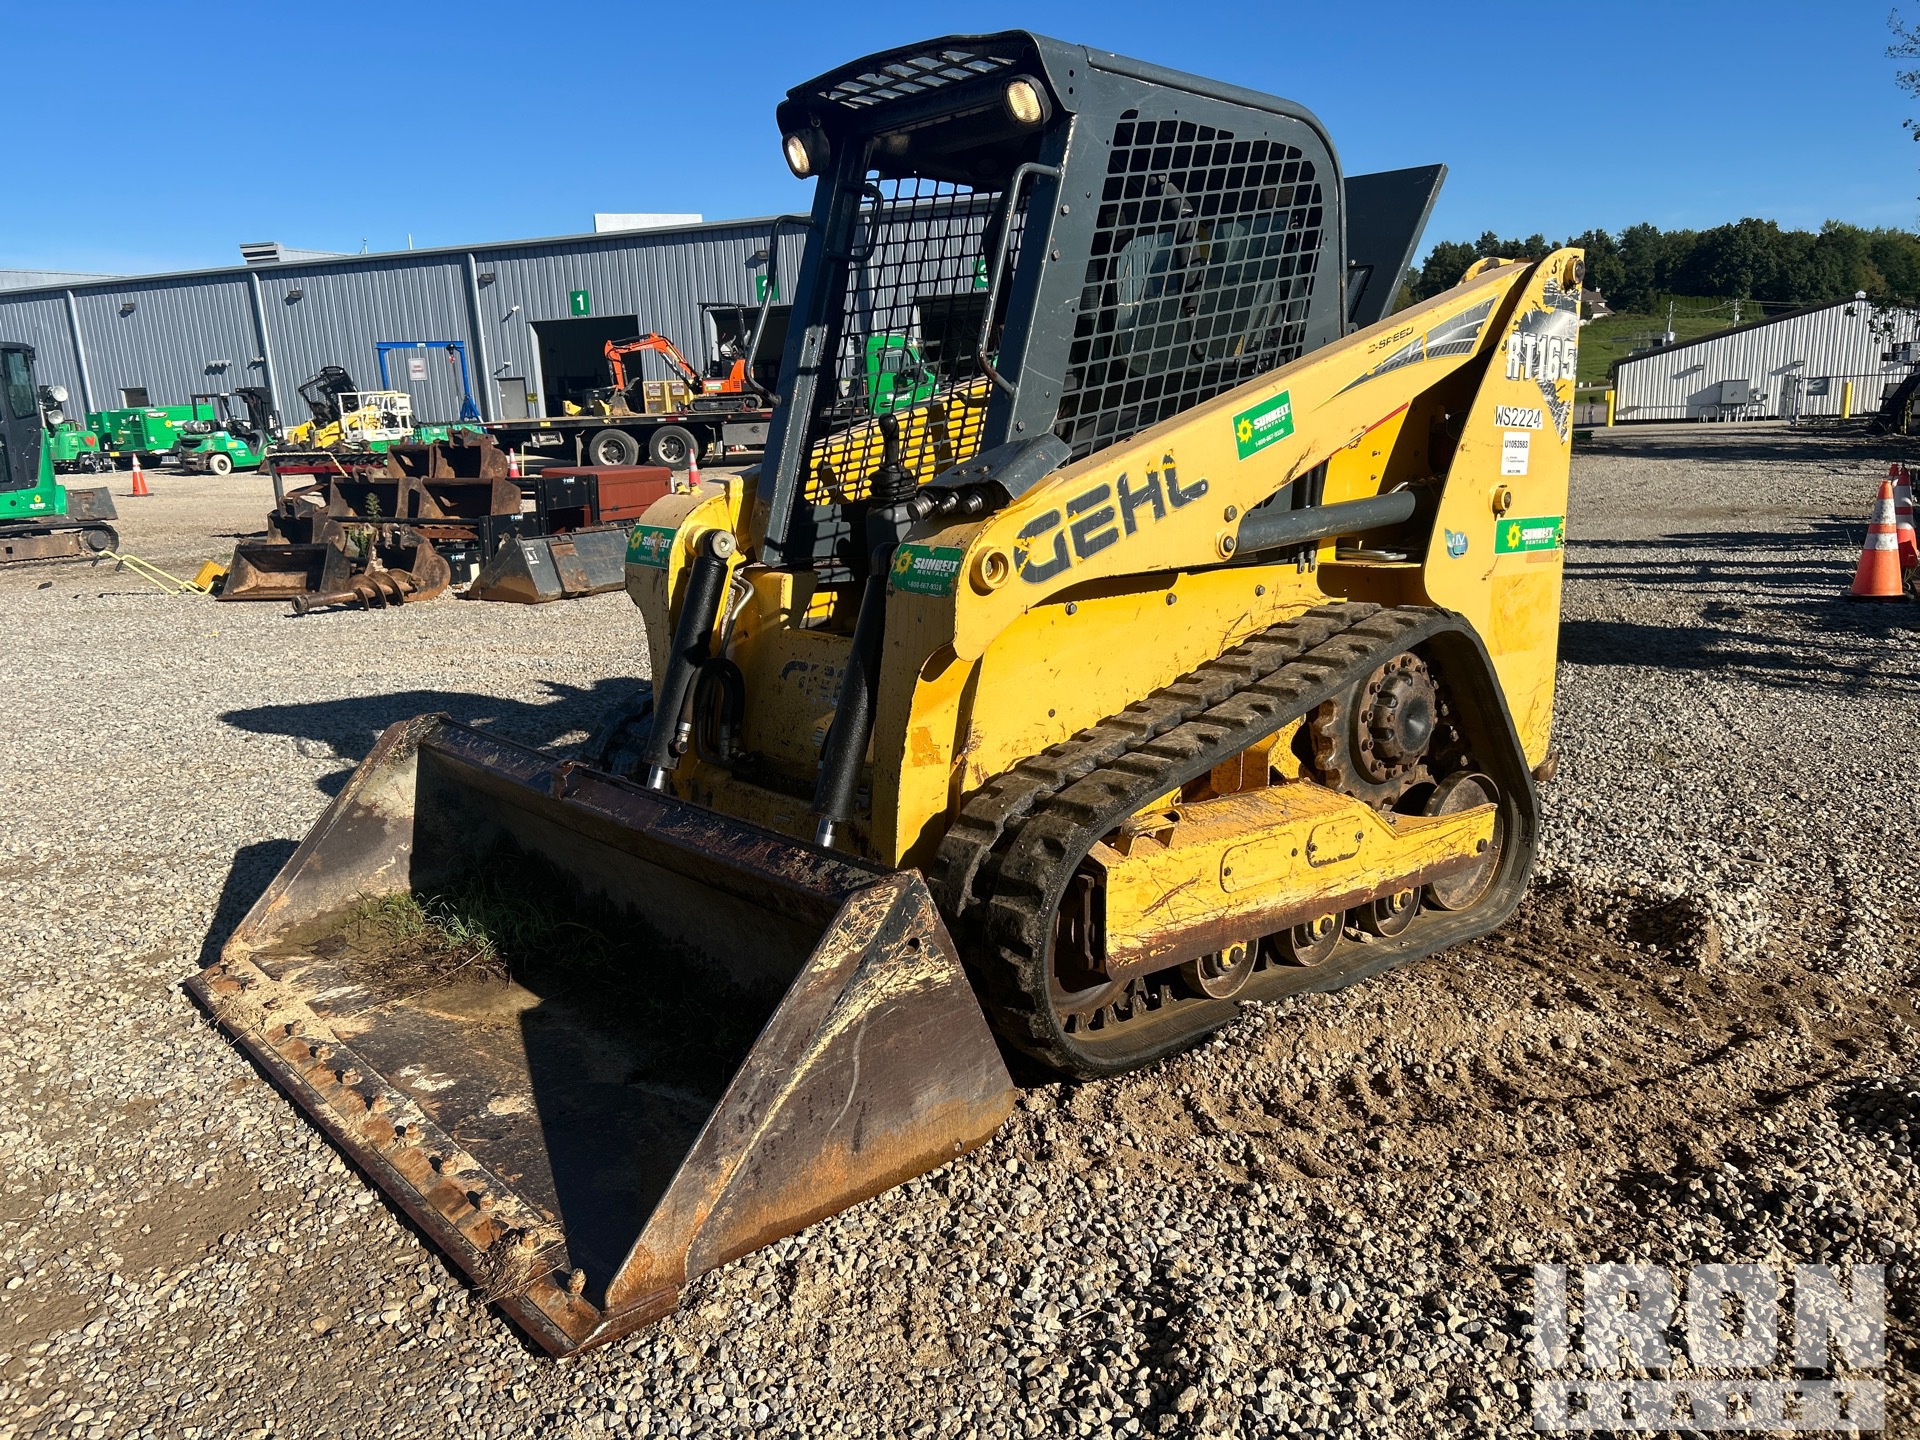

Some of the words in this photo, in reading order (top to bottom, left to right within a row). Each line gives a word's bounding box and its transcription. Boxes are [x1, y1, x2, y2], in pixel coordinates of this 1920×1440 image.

[576, 294, 584, 311] 1
[1253, 402, 1290, 430] SUNBELT
[1259, 415, 1286, 433] RENTALS
[1495, 405, 1541, 428] WS2224
[1013, 452, 1209, 584] GEHL
[642, 535, 672, 549] SUNELT
[912, 557, 960, 573] SUNBELT
[916, 570, 950, 578] RENTALS
